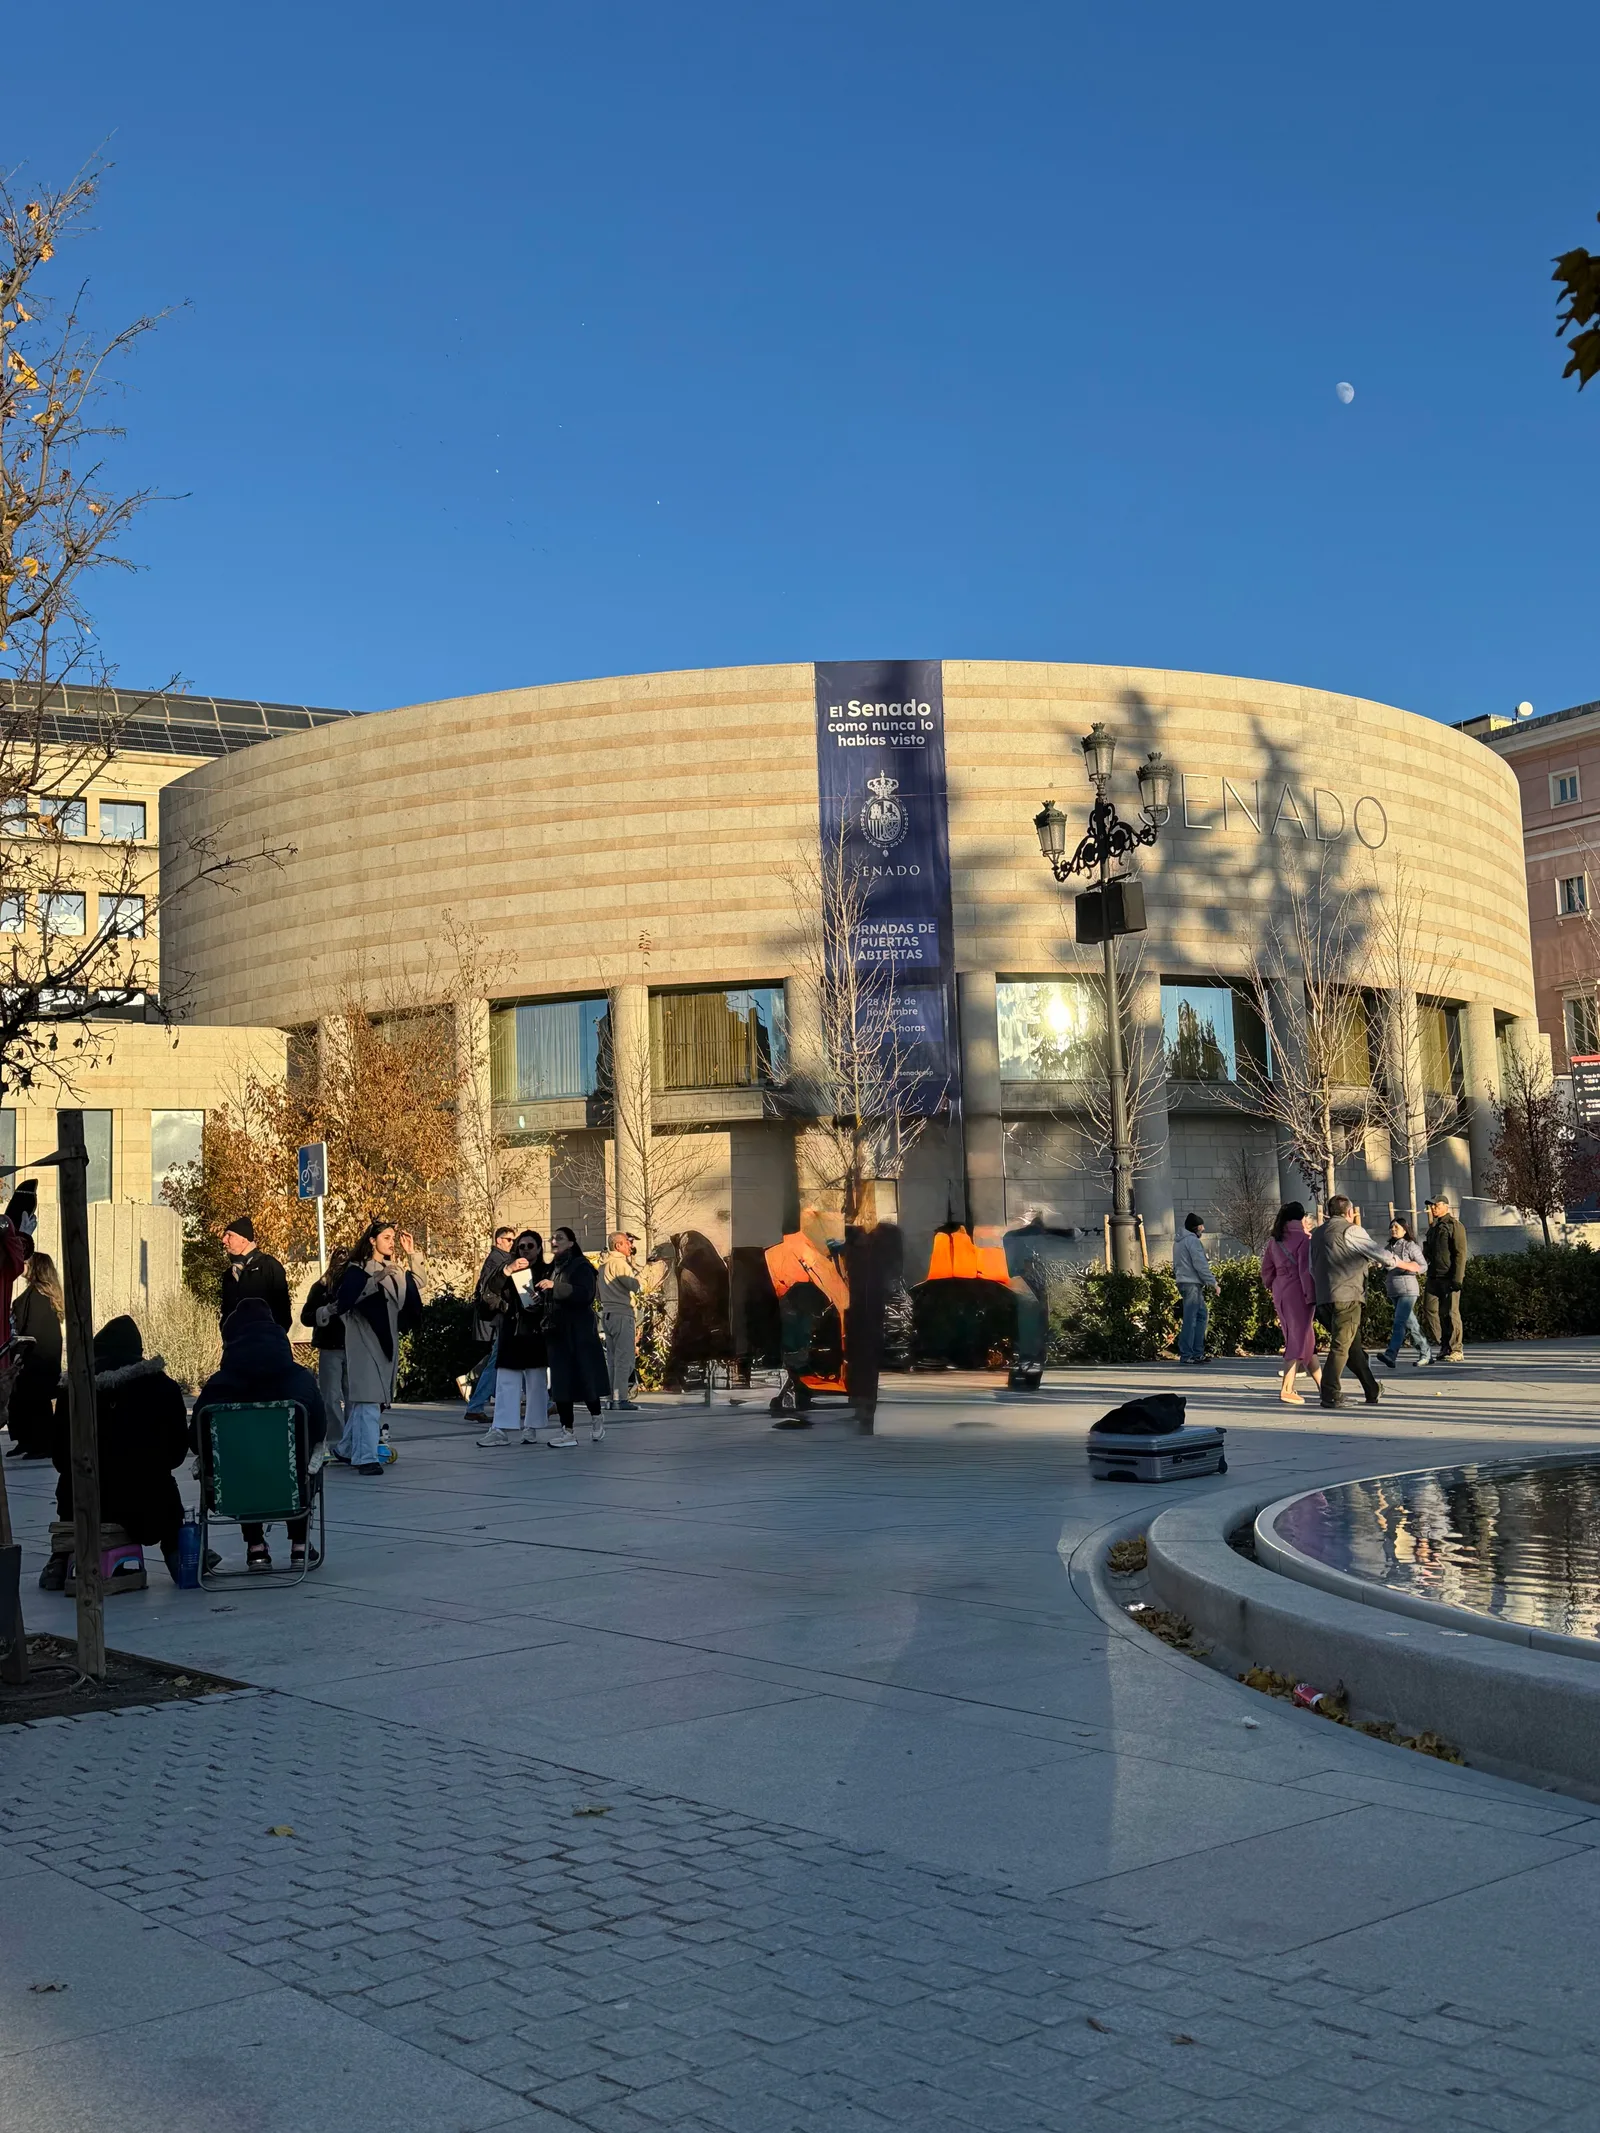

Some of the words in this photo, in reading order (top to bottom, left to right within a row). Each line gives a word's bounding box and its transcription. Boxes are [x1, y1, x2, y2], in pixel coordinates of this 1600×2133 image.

[830, 705, 843, 718] El
[847, 699, 931, 717] Senado
[828, 722, 868, 732] como
[872, 721, 916, 731] nunca
[920, 719, 934, 730] lo
[837, 734, 886, 747] habías
[890, 733, 925, 745] visto
[853, 865, 920, 876] SENADO
[848, 924, 914, 934] ORNADAS
[918, 923, 936, 933] DE
[861, 936, 919, 947] PUERTAS
[858, 949, 923, 960] ABIERTAS
[867, 998, 879, 1006] 28
[904, 997, 916, 1005] de
[867, 1007, 918, 1016] novimbre
[898, 1024, 926, 1033] horas
